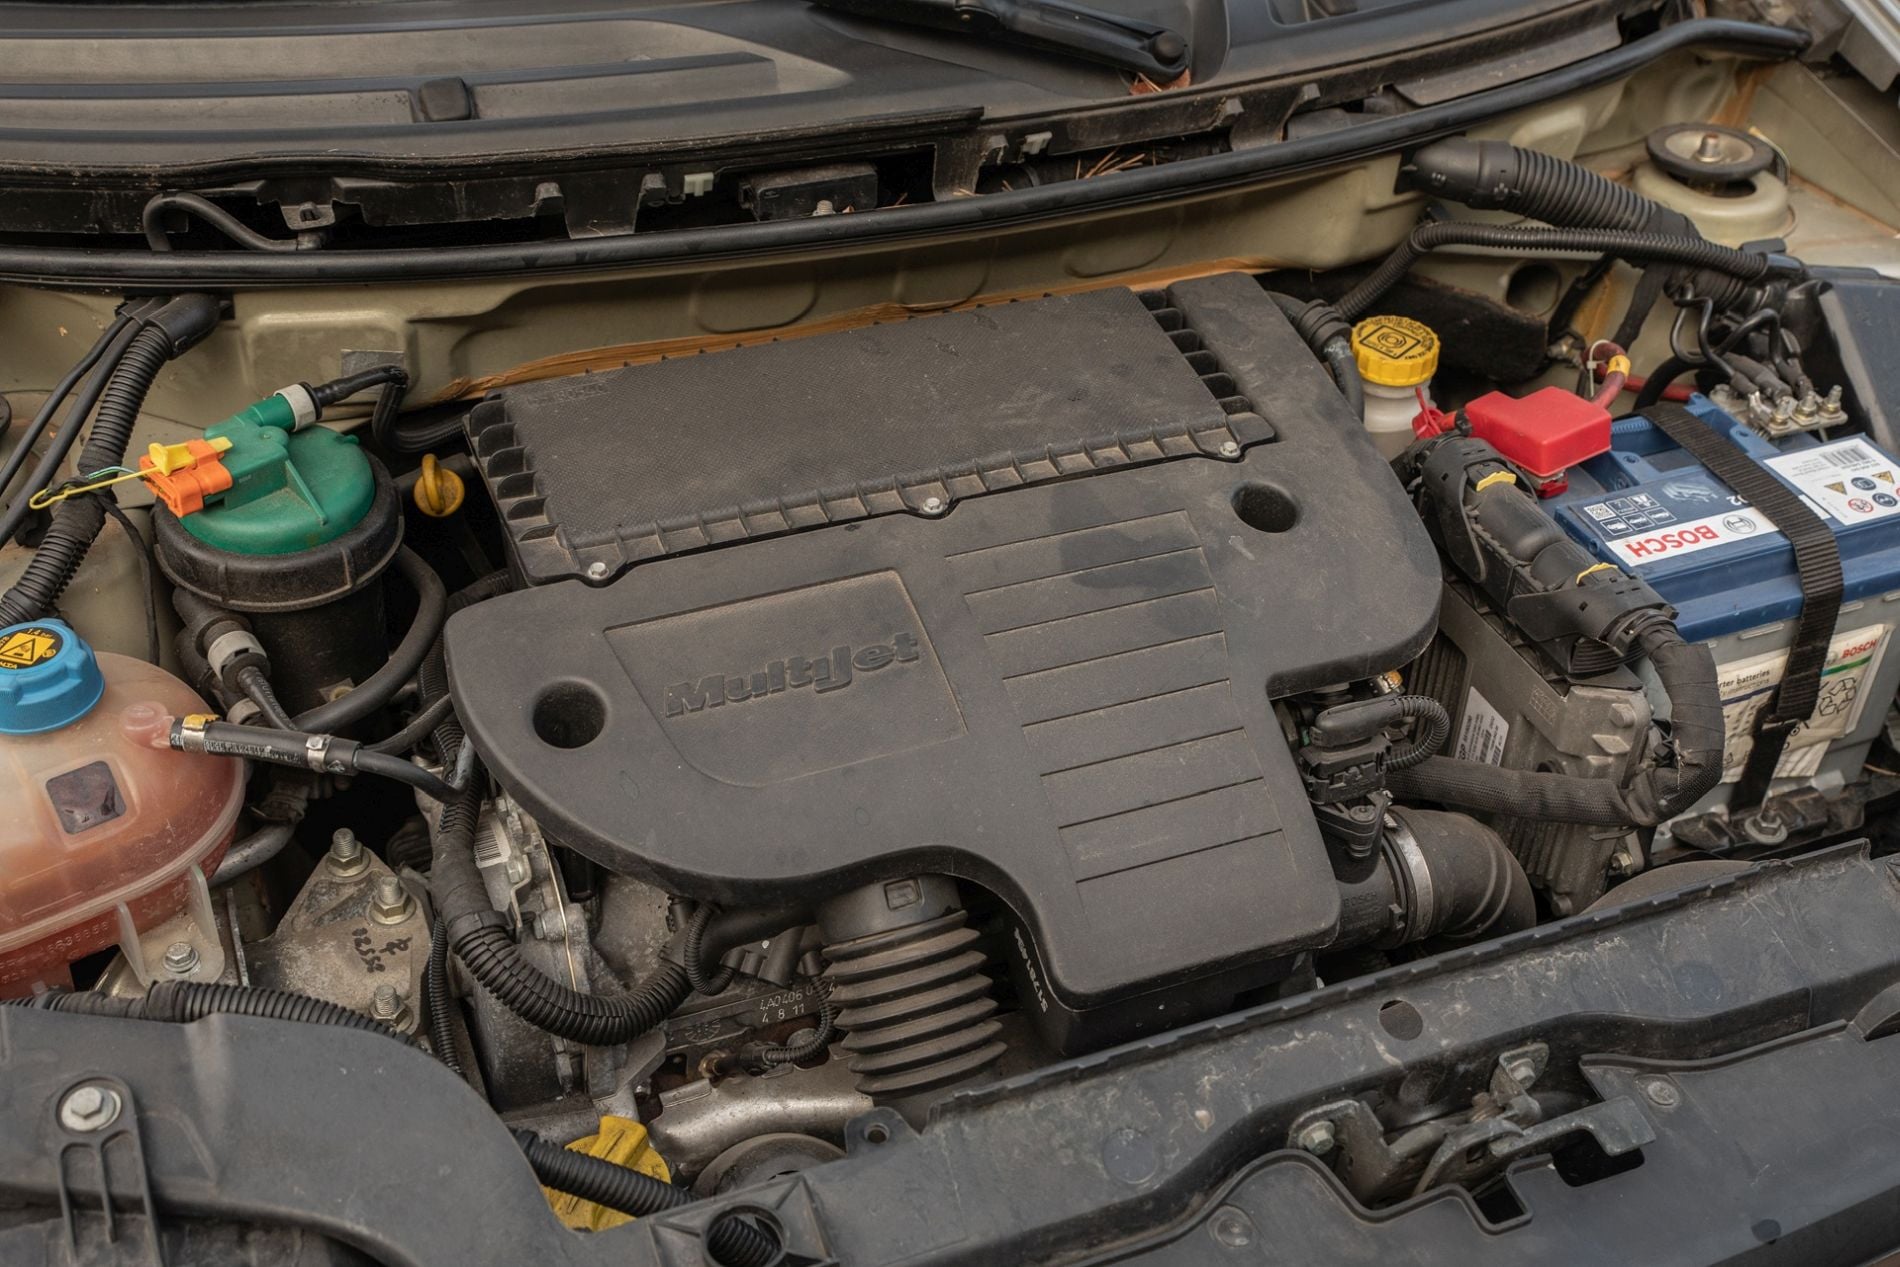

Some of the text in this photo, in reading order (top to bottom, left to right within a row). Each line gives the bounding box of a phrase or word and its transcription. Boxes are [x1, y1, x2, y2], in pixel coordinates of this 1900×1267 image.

[1625, 525, 1719, 557] BOSCH
[1841, 639, 1877, 658] BOSCH
[664, 632, 919, 718] MultiJet
[1736, 669, 1770, 684] batteries
[777, 1008, 785, 1020] 8
